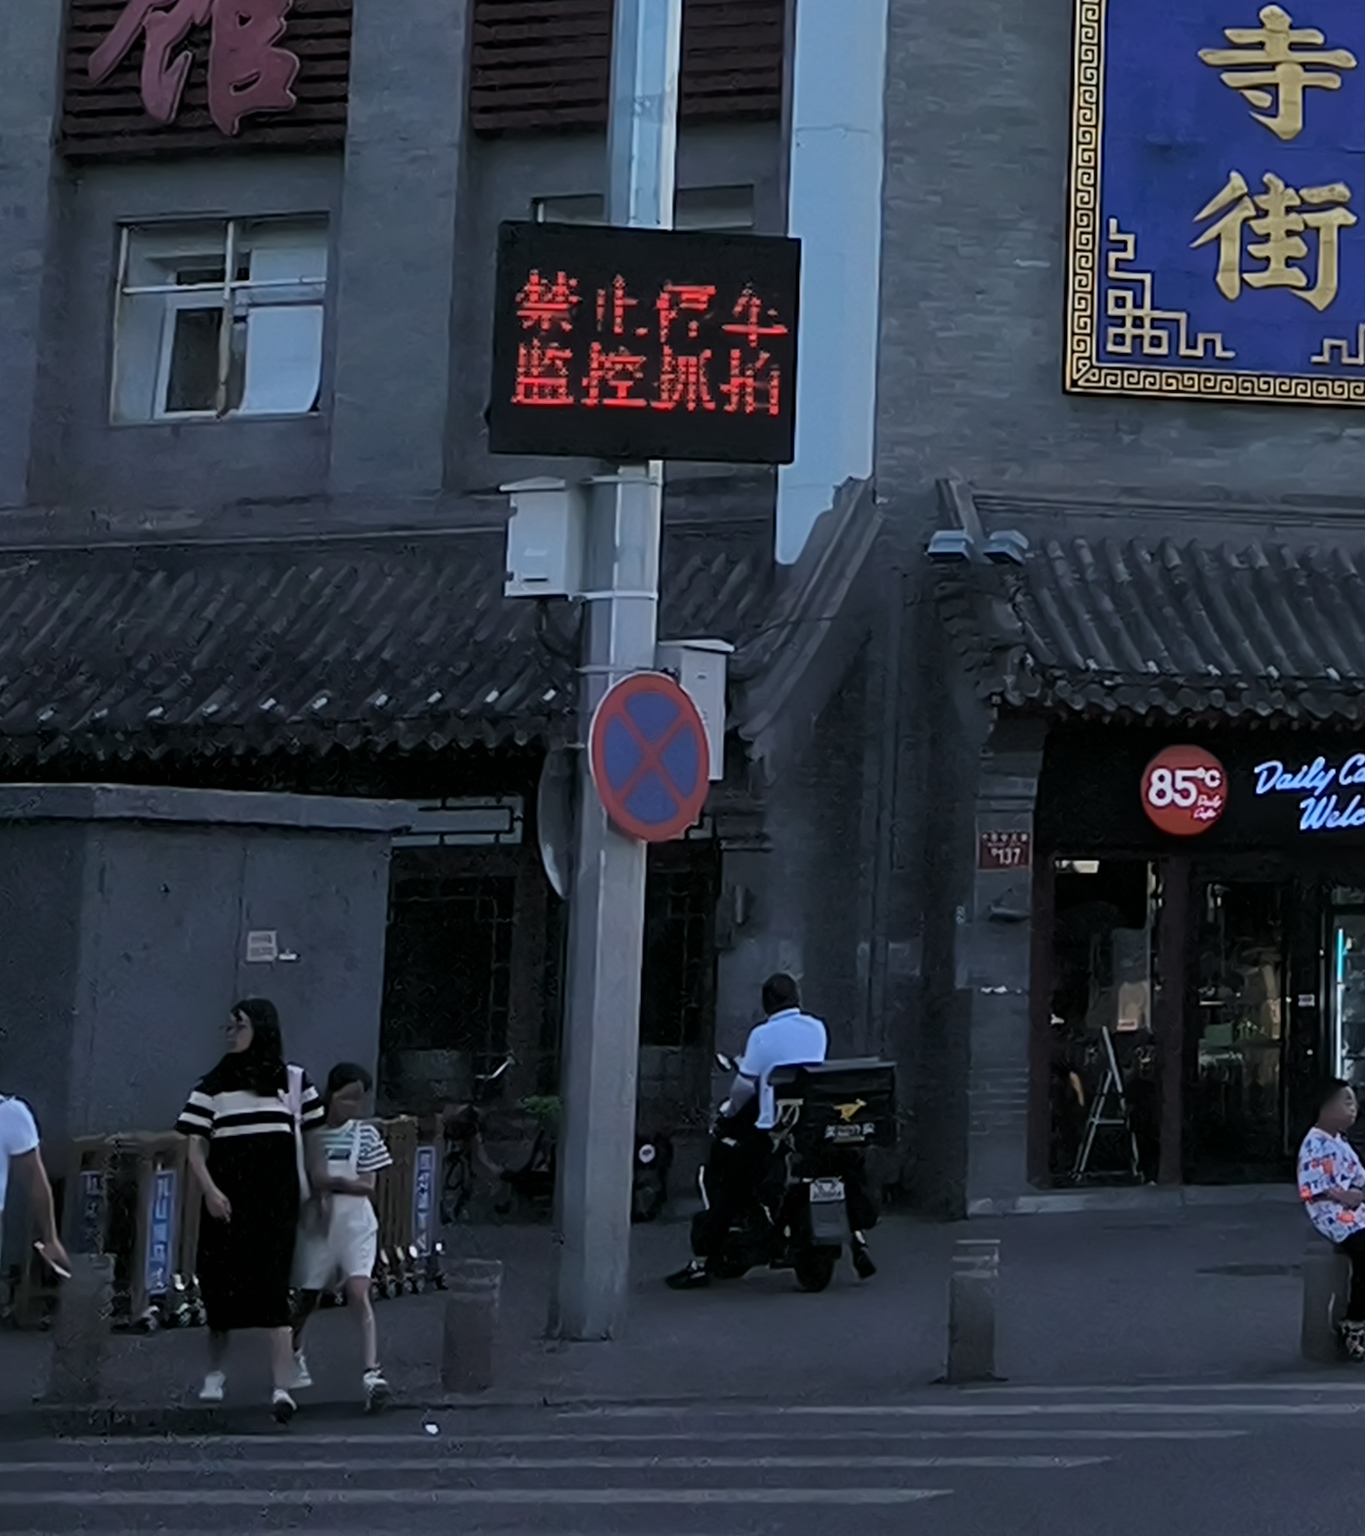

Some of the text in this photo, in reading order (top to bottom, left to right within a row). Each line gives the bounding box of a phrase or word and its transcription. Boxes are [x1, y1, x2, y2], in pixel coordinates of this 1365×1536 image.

[511, 338, 781, 415] 监控抓拍
[1254, 756, 1336, 795] Daily
